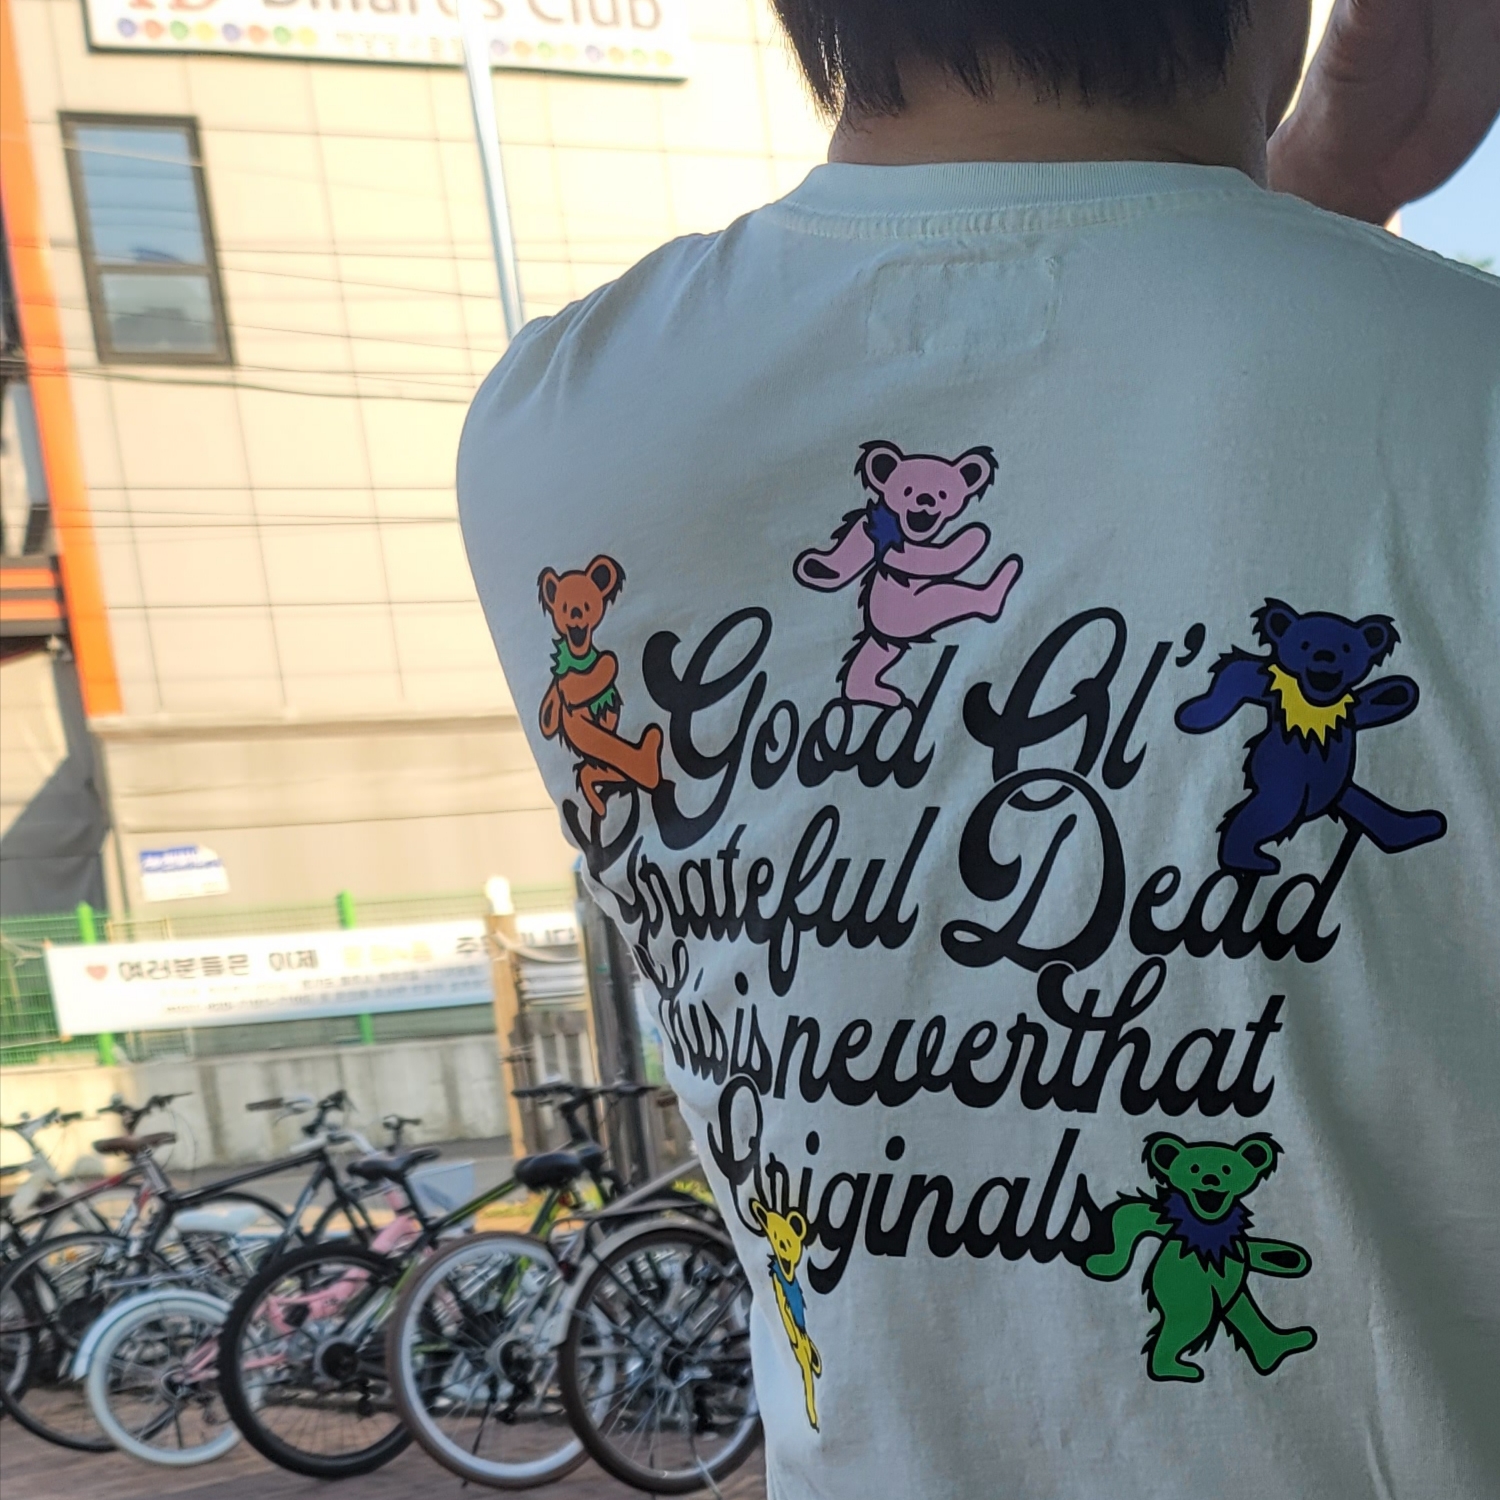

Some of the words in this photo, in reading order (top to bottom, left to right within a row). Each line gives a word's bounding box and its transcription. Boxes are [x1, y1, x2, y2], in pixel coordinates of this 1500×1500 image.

[643, 607, 957, 850] Good
[118, 954, 249, 981] 여러분들은
[268, 950, 319, 972] 이제
[562, 785, 940, 996] Grateful
[941, 768, 1360, 973] Dead
[709, 1076, 1116, 1293] Originals
